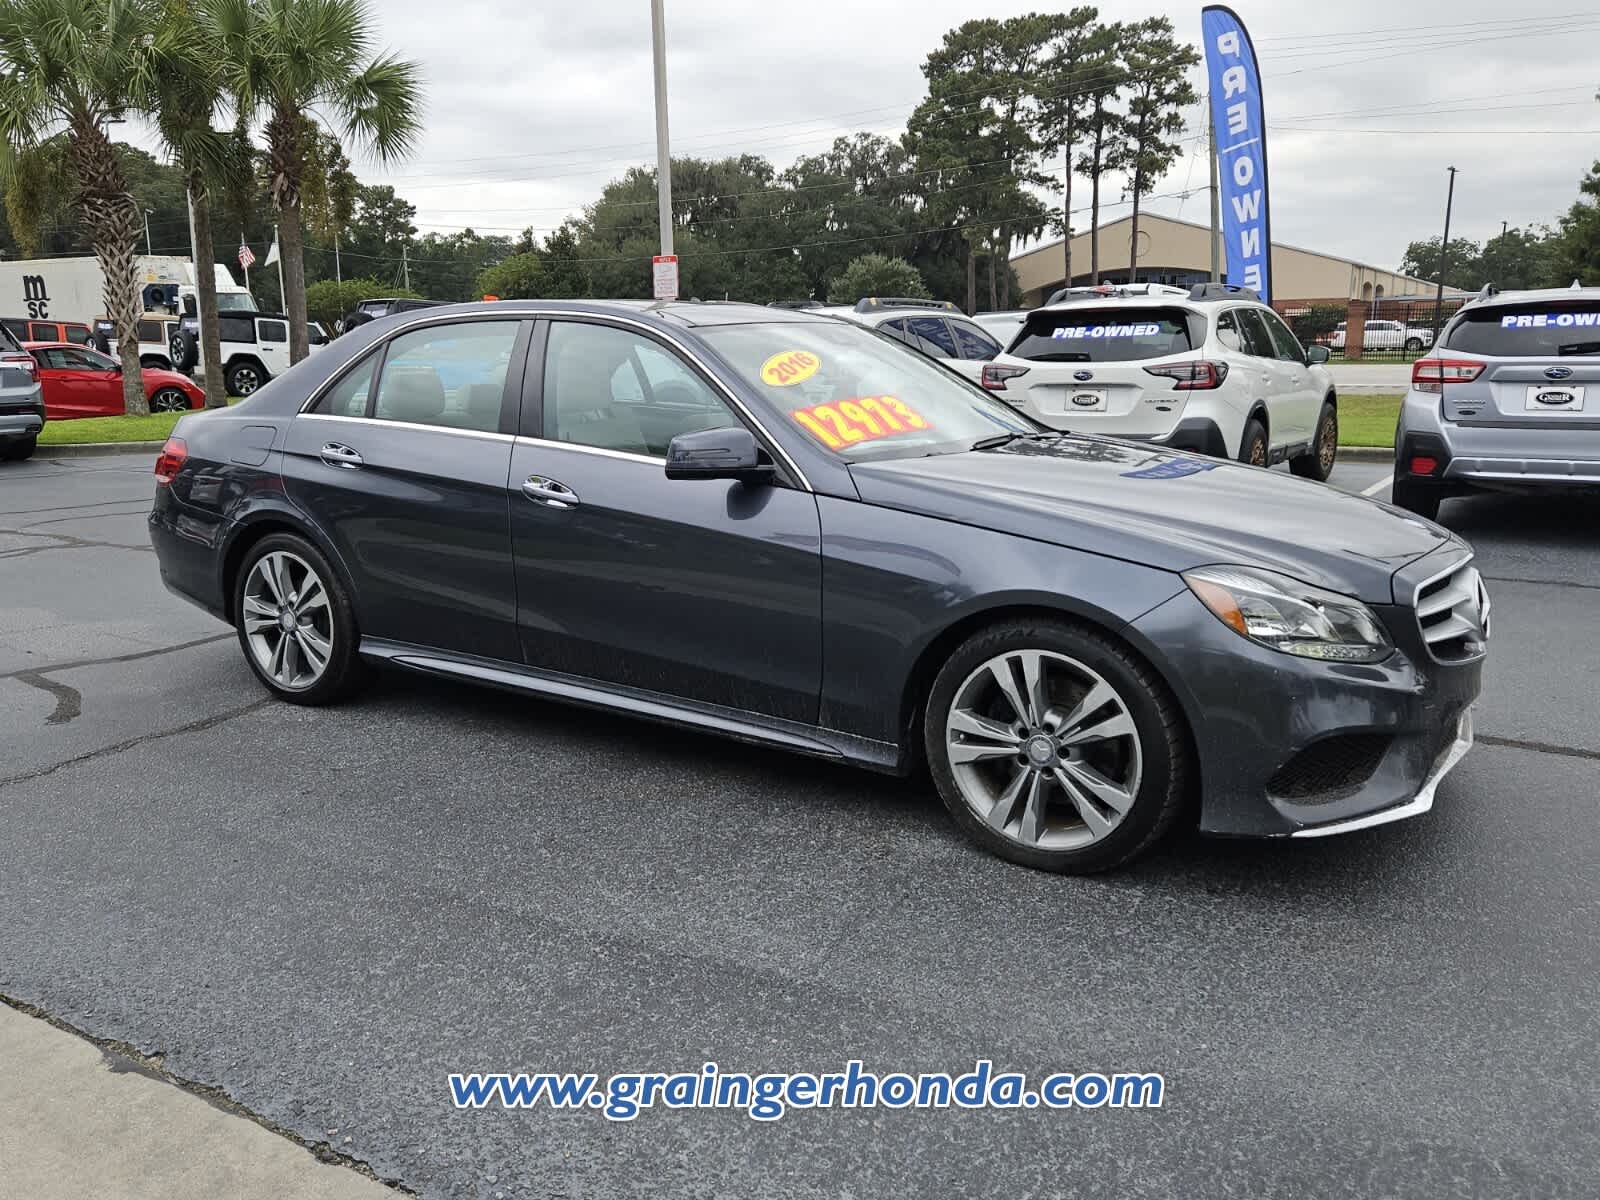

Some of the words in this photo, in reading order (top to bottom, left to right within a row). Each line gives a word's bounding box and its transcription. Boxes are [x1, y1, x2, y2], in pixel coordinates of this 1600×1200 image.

[1051, 324, 1160, 338] PRE-OWNED
[1501, 313, 1600, 327] PRE-OW
[768, 352, 816, 383] 2016
[794, 396, 928, 447] 12973
